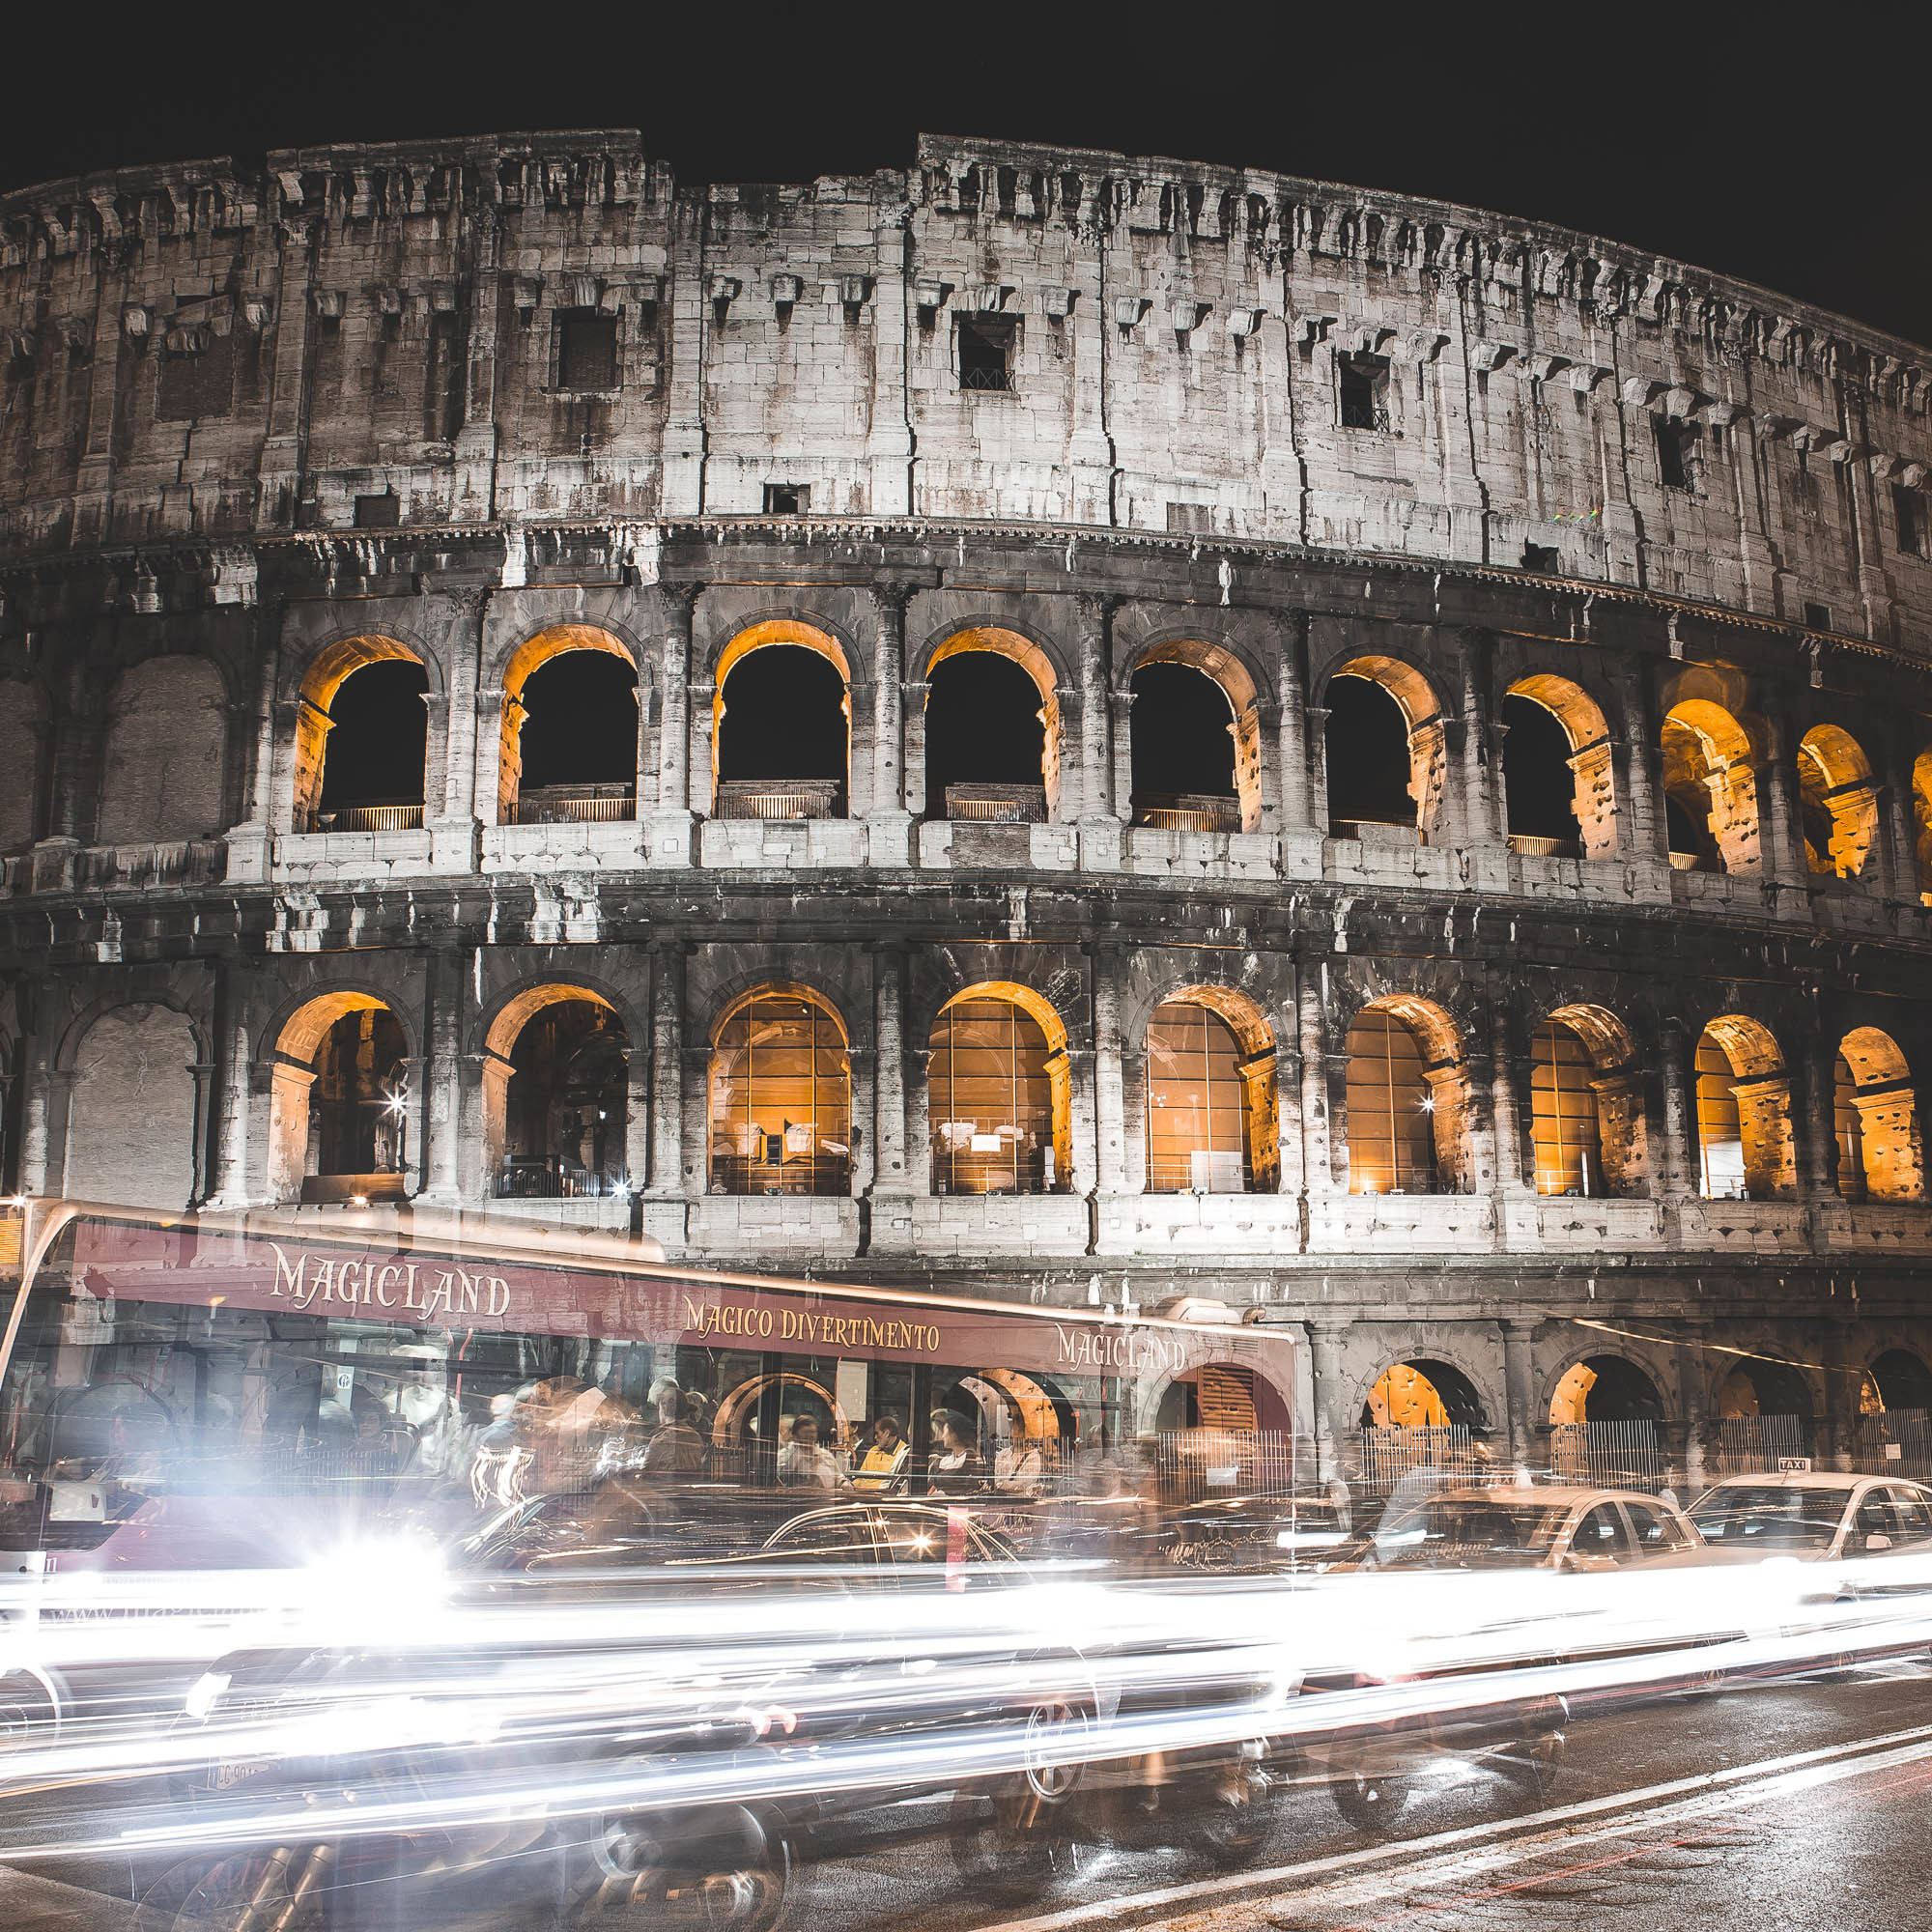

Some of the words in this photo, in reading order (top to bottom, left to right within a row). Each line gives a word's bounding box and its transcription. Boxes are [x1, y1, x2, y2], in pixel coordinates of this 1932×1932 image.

[268, 1242, 511, 1321] MAGICLAND
[683, 1295, 773, 1340] MAGICO
[780, 1308, 941, 1351] DIVERTIMENTO
[1054, 1322, 1186, 1377] MAGICLAND
[1780, 1460, 1805, 1469] TAXI
